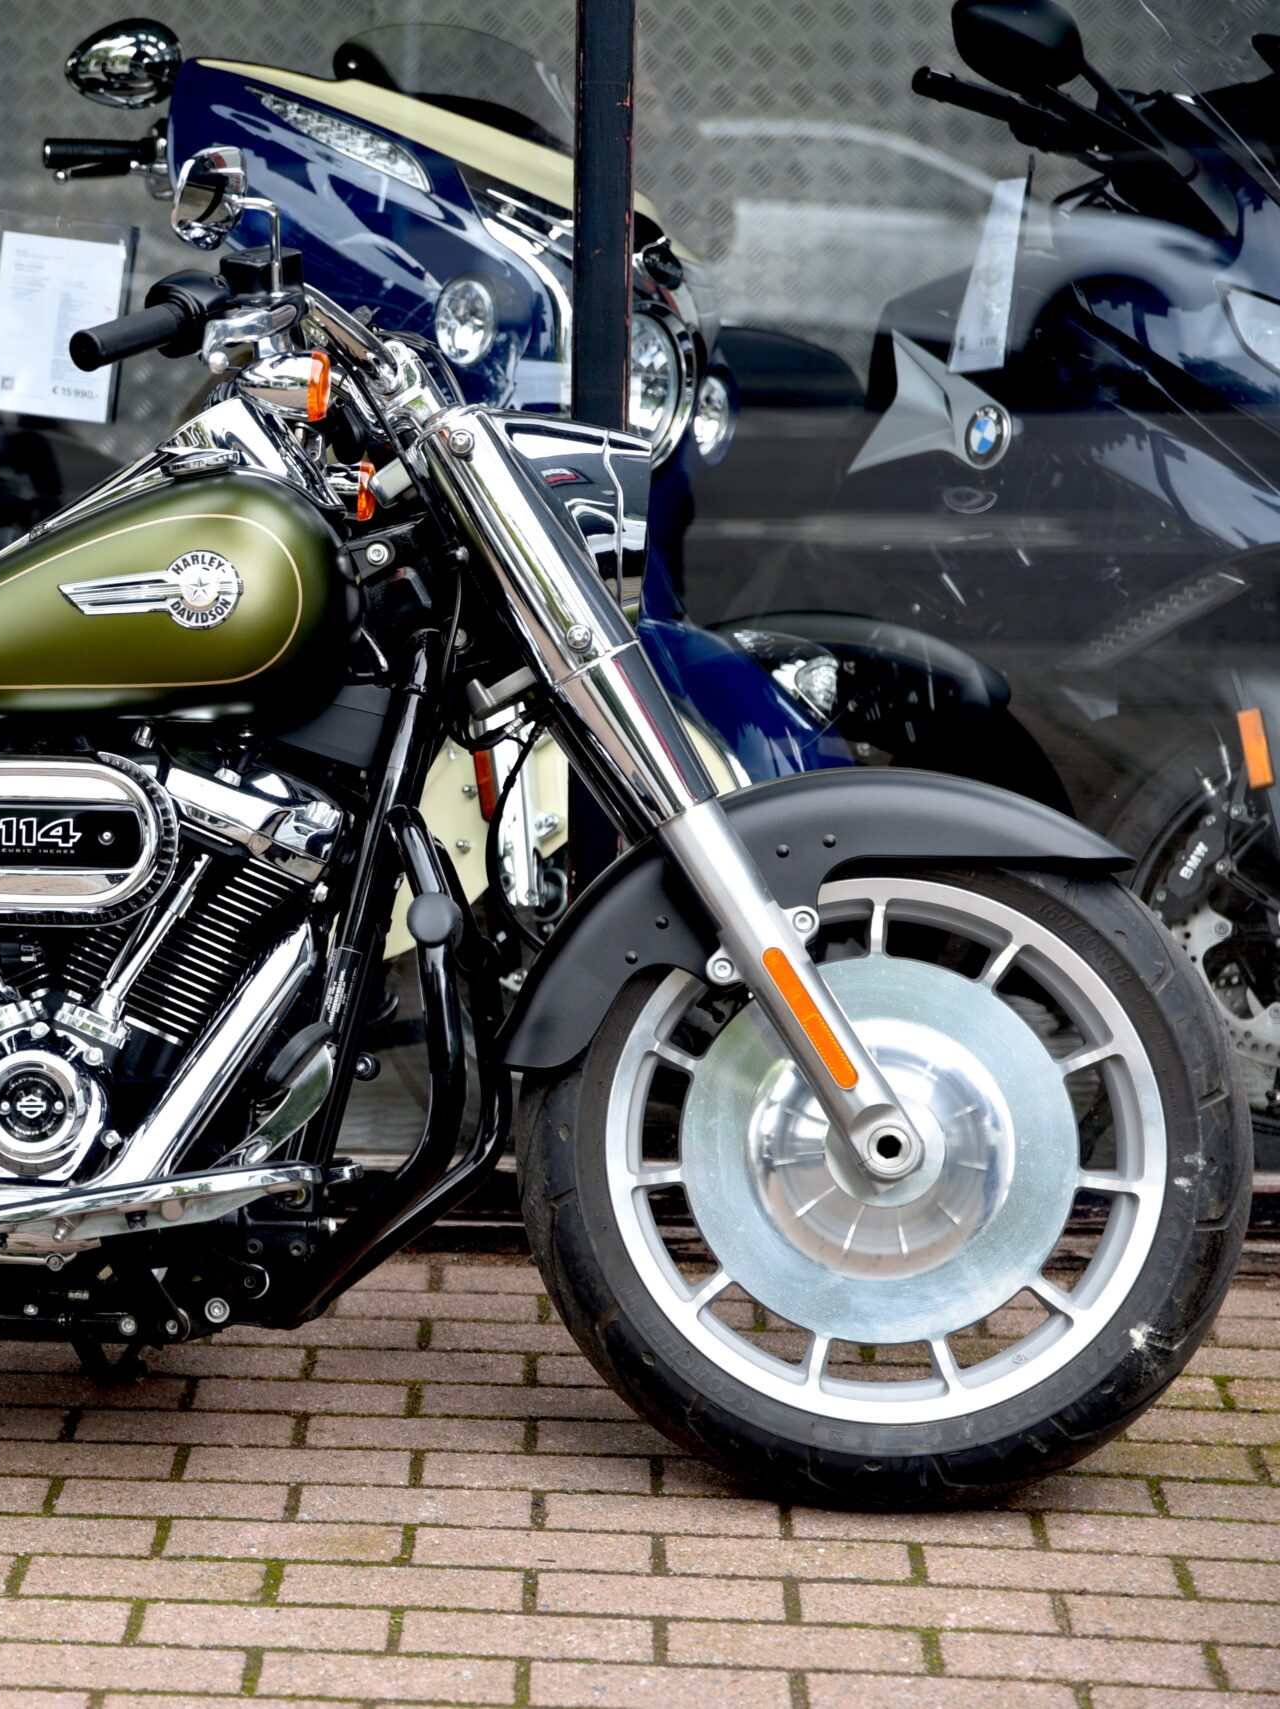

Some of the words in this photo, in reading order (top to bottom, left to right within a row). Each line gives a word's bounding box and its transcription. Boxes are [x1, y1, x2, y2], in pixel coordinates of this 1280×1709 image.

[170, 598, 232, 624] DAVIDSON
[0, 817, 83, 847] 114
[1179, 841, 1209, 880] BMW
[641, 1317, 753, 1412] SCORCHER
